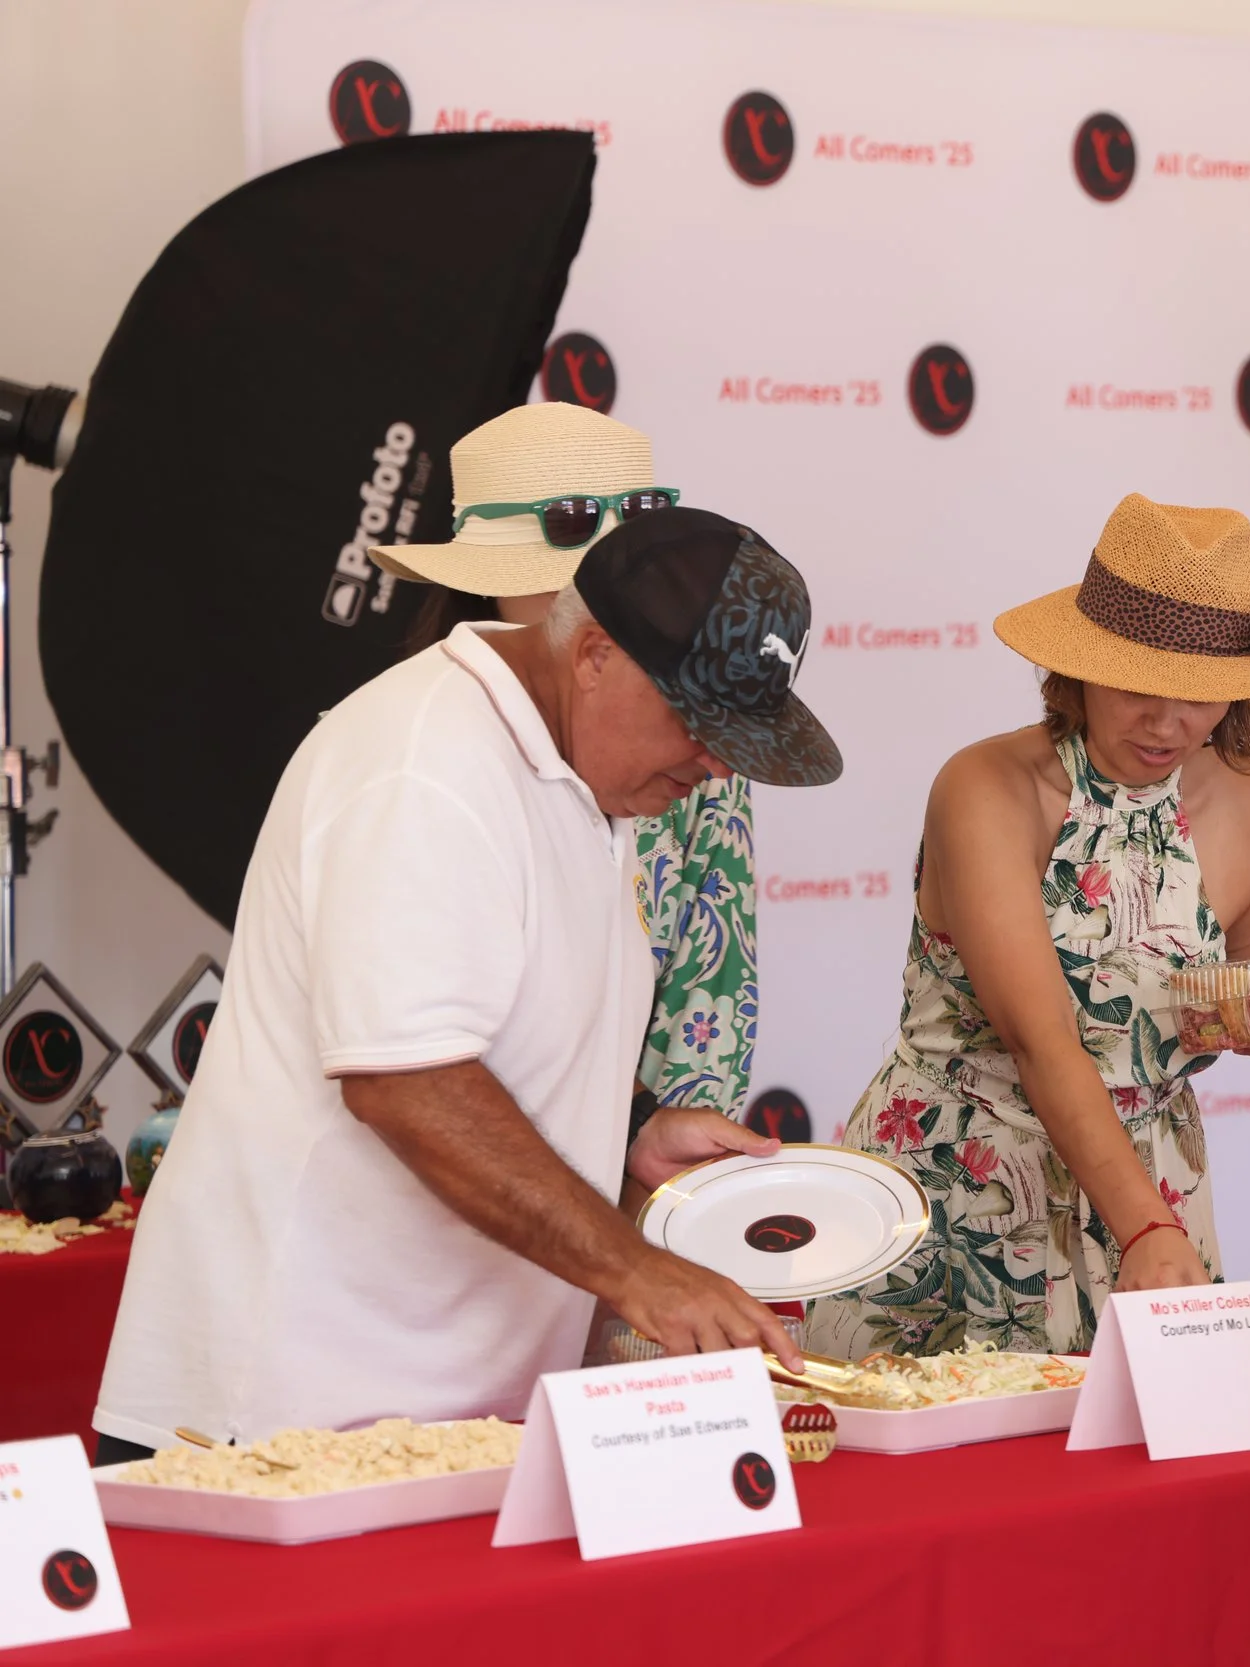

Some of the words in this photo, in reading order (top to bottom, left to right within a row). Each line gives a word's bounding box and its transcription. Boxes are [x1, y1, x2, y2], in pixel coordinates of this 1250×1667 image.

[816, 136, 846, 160] All
[850, 136, 936, 165] Comers
[941, 140, 975, 168] '25
[1155, 154, 1183, 177] All
[720, 377, 751, 404] All
[755, 377, 844, 407] Comers
[848, 380, 884, 408] '25
[1066, 385, 1095, 410] All
[1099, 385, 1179, 412] Comers
[1181, 386, 1213, 413] '25
[336, 422, 415, 582] Profoto
[822, 624, 852, 648] All
[856, 622, 942, 651] Comers
[945, 622, 980, 649] '25
[765, 875, 853, 904] Comers
[856, 870, 892, 899] '25
[1150, 1301, 1180, 1316] Mo's
[1181, 1298, 1213, 1312] Killer
[1160, 1322, 1210, 1337] Courtesy
[1213, 1319, 1224, 1332] of
[1226, 1318, 1243, 1331] Mo
[625, 1371, 689, 1393] Hawaiian
[691, 1366, 735, 1384] Island
[645, 1400, 687, 1416] Pasta
[591, 1431, 650, 1450] Courtesy
[653, 1425, 665, 1441] of
[669, 1423, 693, 1438] Sae
[694, 1416, 749, 1435] Edwards
